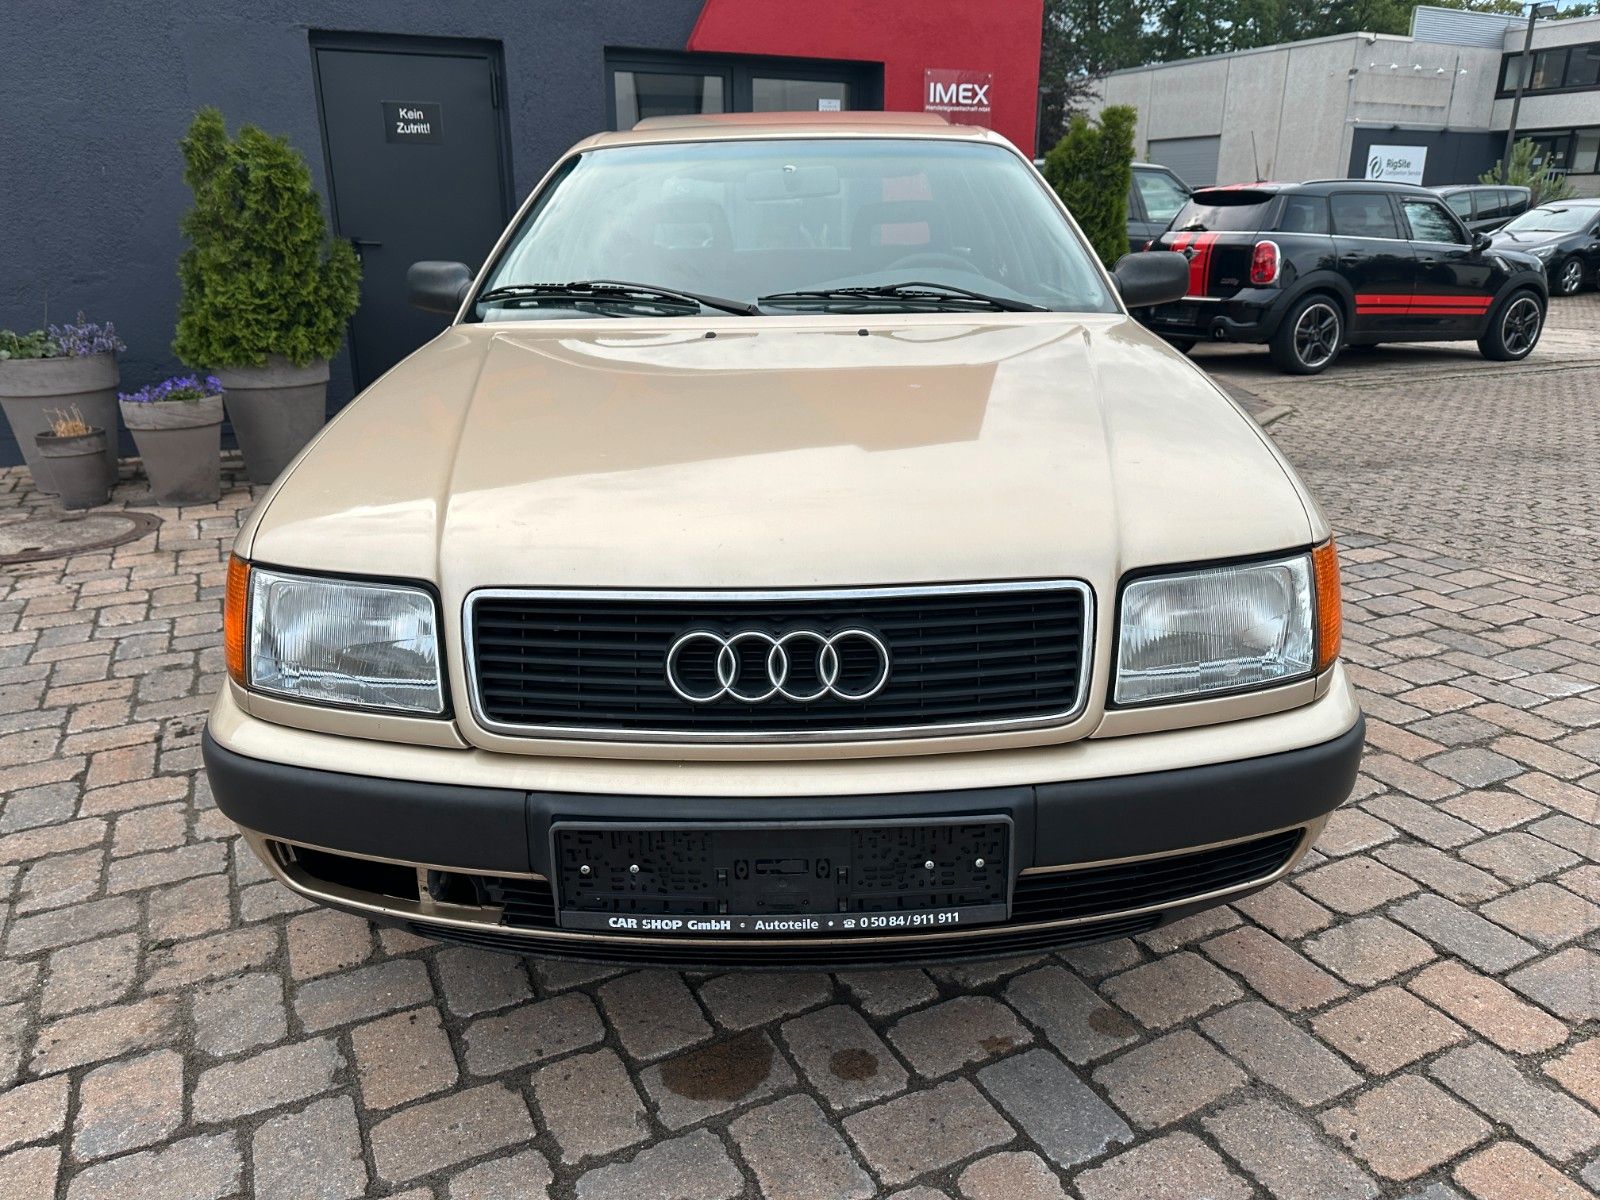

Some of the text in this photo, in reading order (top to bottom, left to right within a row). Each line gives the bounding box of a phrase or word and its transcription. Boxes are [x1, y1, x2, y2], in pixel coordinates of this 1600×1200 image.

[929, 82, 989, 104] IMEX
[399, 108, 423, 119] Kein
[396, 122, 430, 133] Zutritt!
[1386, 159, 1411, 169] RigSite
[608, 917, 637, 928] CAR
[642, 919, 682, 930] SHOP
[687, 920, 730, 930] GmbH
[755, 919, 818, 930] Autoteile
[938, 912, 959, 923] 911
